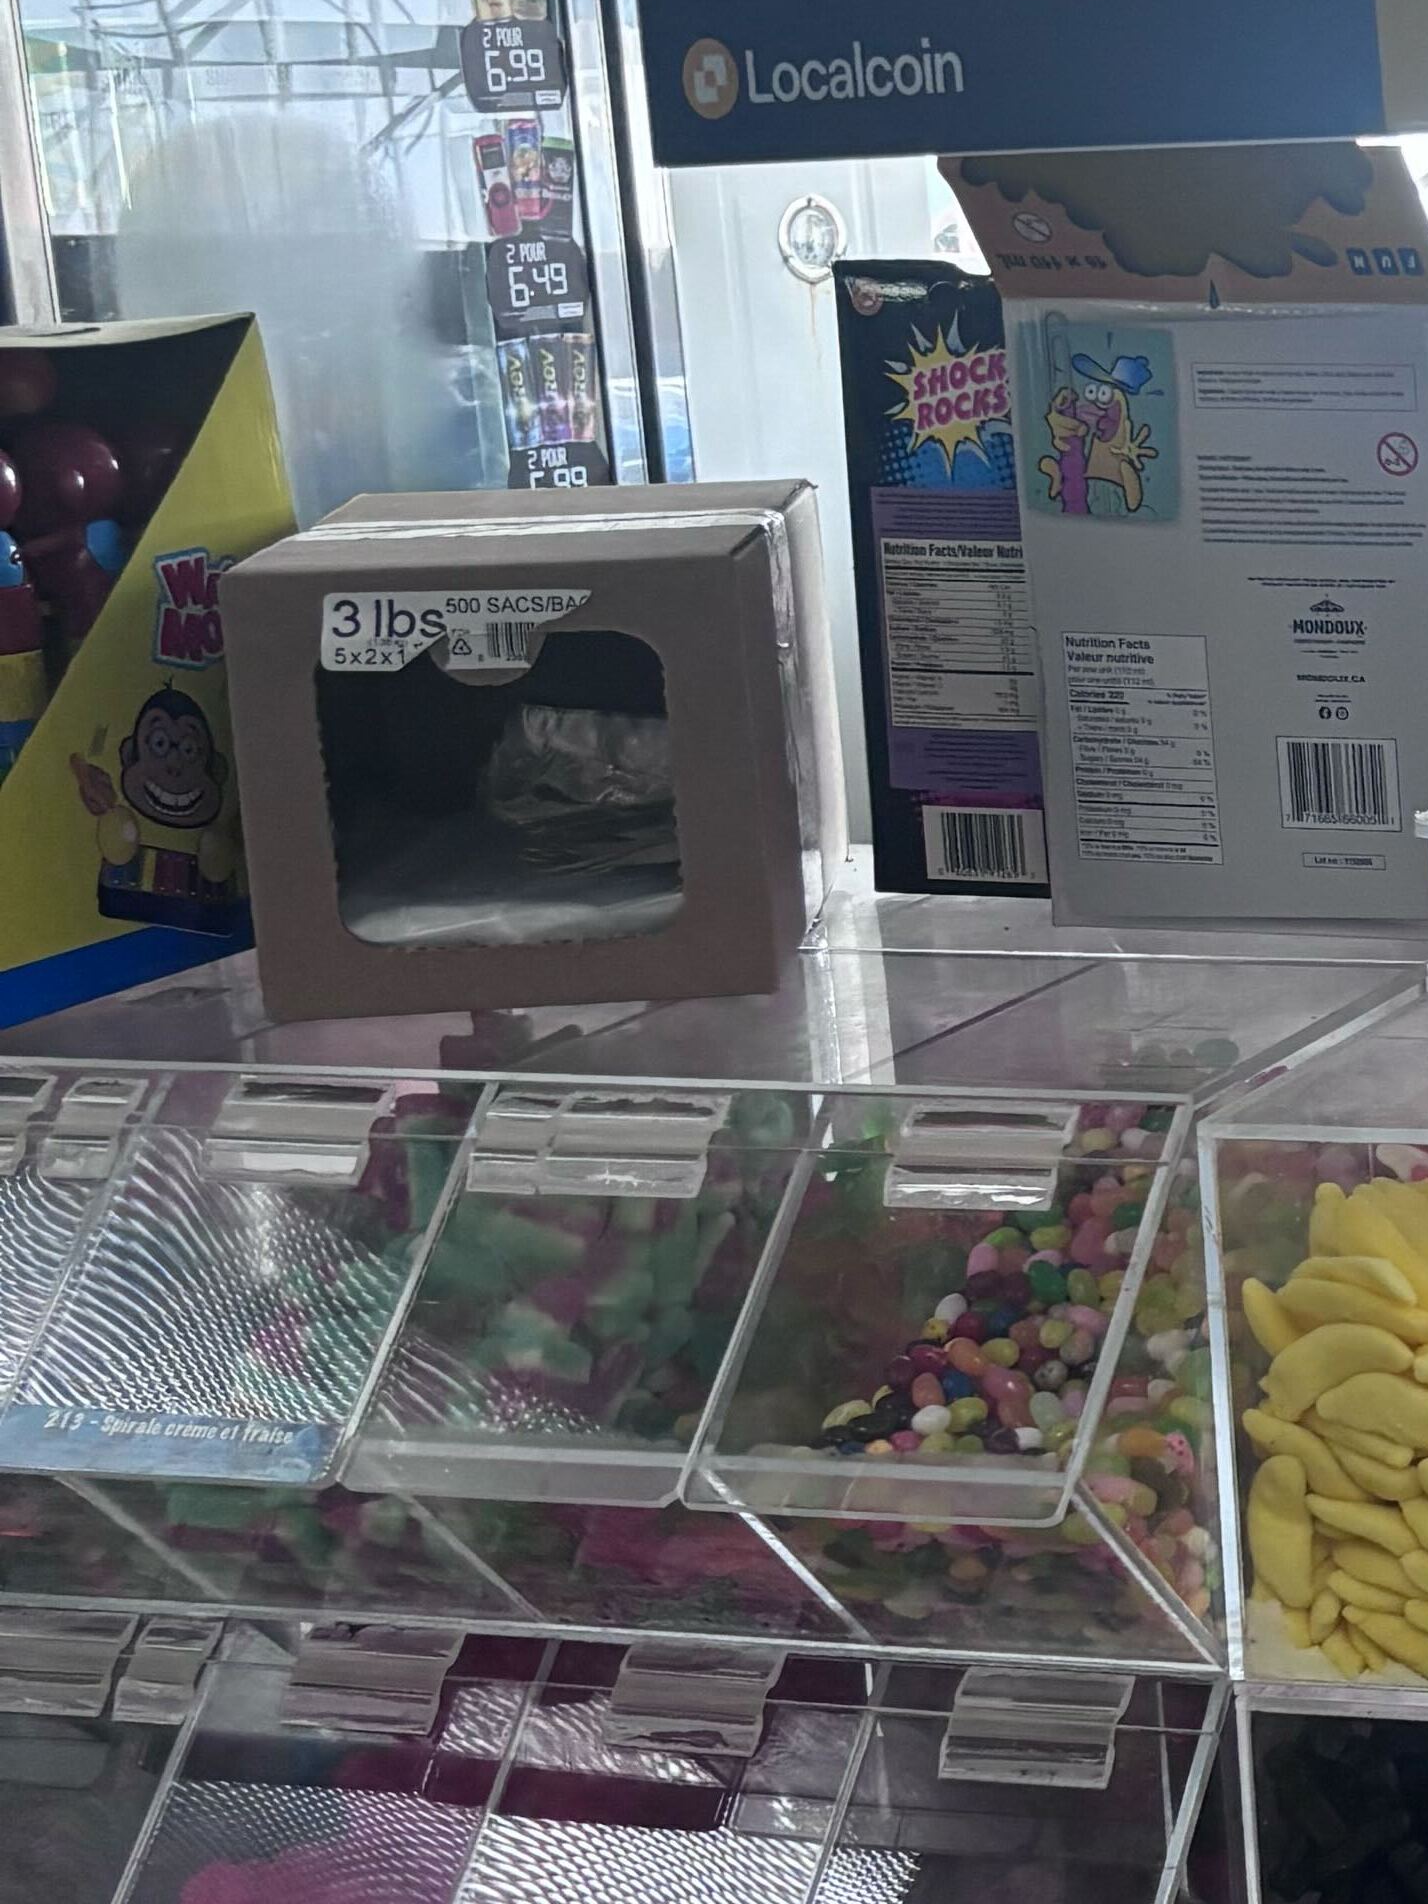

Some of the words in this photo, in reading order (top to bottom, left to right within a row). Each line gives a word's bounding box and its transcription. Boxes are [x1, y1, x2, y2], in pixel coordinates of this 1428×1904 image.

[483, 47, 547, 93] 6.99
[746, 37, 963, 105] Localcoin
[507, 261, 568, 308] 6.49
[913, 351, 1006, 401] SHOCK
[916, 383, 1009, 432] ROCKS
[331, 599, 361, 639] 3
[374, 599, 447, 640] lbs
[445, 597, 481, 614] 500
[1292, 619, 1366, 637] MONDOUX
[43, 1410, 85, 1431] 213
[101, 1414, 162, 1437] Spirale
[164, 1422, 216, 1441] crème
[219, 1425, 238, 1441] et
[242, 1421, 294, 1445] fraise
